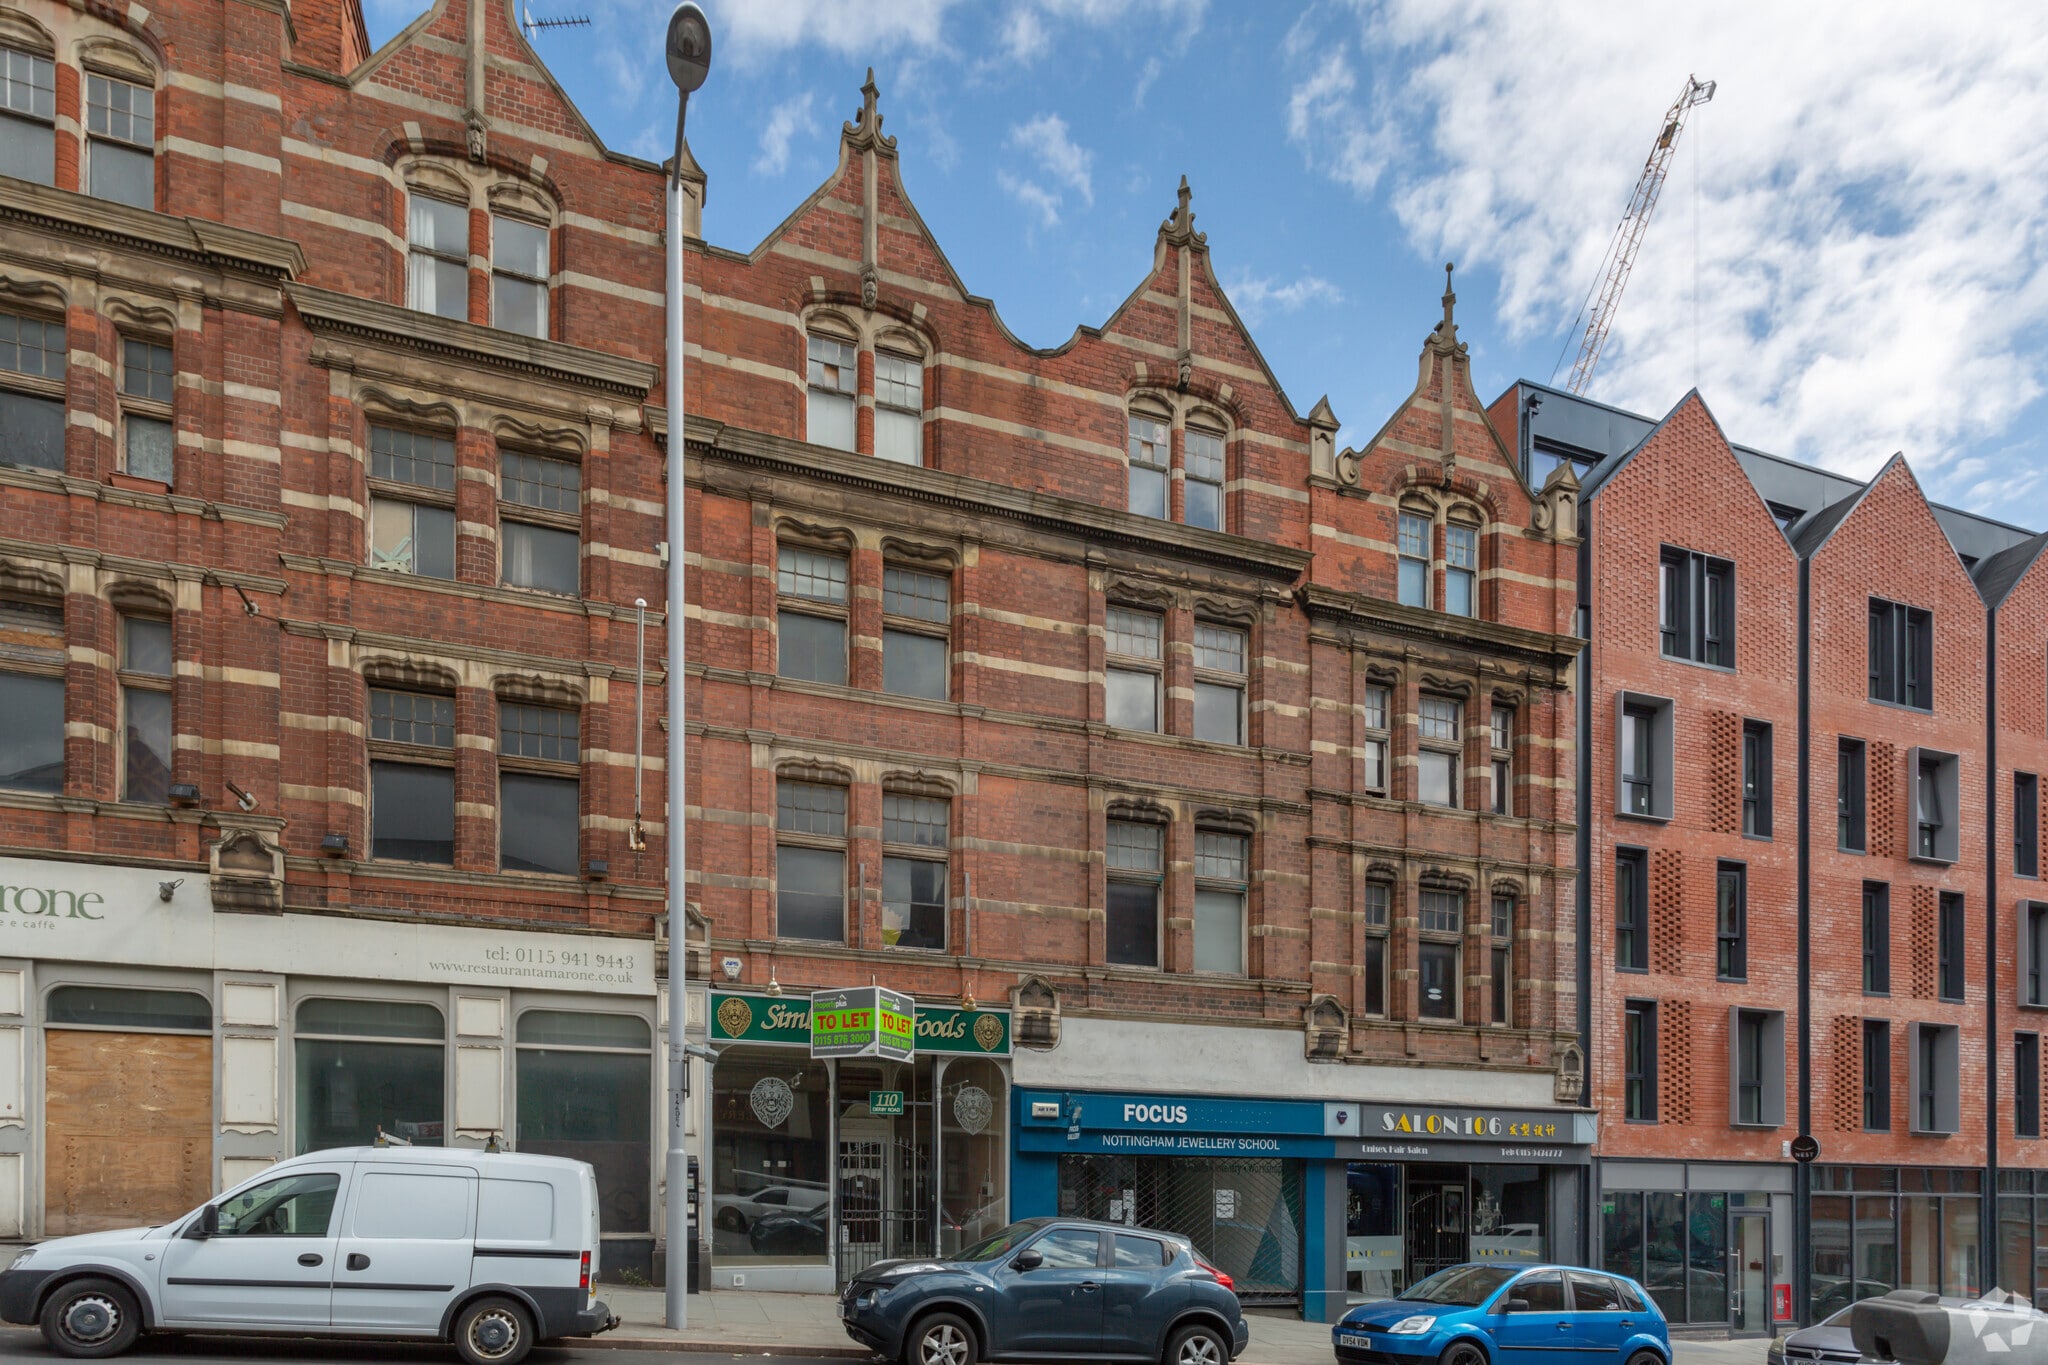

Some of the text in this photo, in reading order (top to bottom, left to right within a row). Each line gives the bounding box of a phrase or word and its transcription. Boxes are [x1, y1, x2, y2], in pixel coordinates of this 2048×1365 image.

[485, 947, 634, 969] tel: 0115 941 9443
[429, 961, 633, 983] www.restaurantamarone.co.uk
[760, 1004, 812, 1030] Sim
[818, 1012, 870, 1030] TO LET
[882, 1013, 912, 1034] TO LET
[814, 1034, 832, 1046] 0115
[850, 1033, 871, 1044] 3000
[875, 1094, 898, 1106] 110
[1124, 1103, 1188, 1123] FOCUS
[1382, 1112, 1501, 1136] SALON 106
[1102, 1134, 1280, 1150] NOTTINGHAM JEWELLERY SCHOOL
